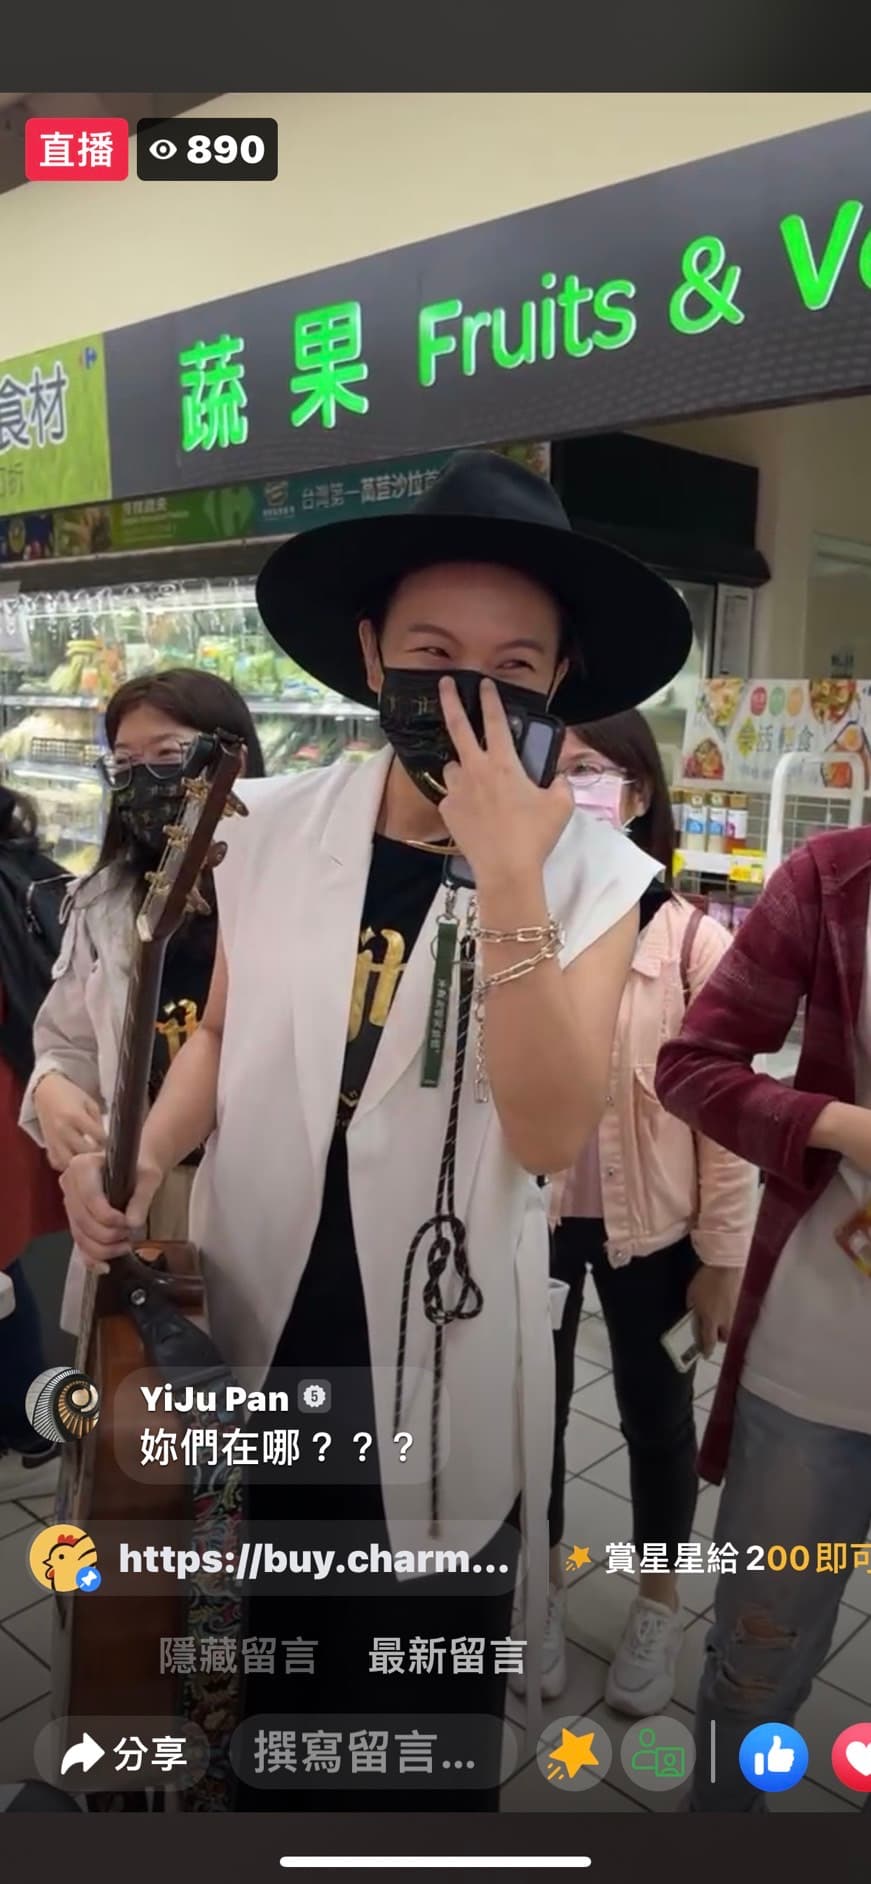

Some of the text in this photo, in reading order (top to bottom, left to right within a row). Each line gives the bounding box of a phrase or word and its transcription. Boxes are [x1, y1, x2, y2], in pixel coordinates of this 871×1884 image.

[179, 300, 369, 452] 蔬果
[418, 272, 637, 387] Fruits
[669, 235, 745, 335] &
